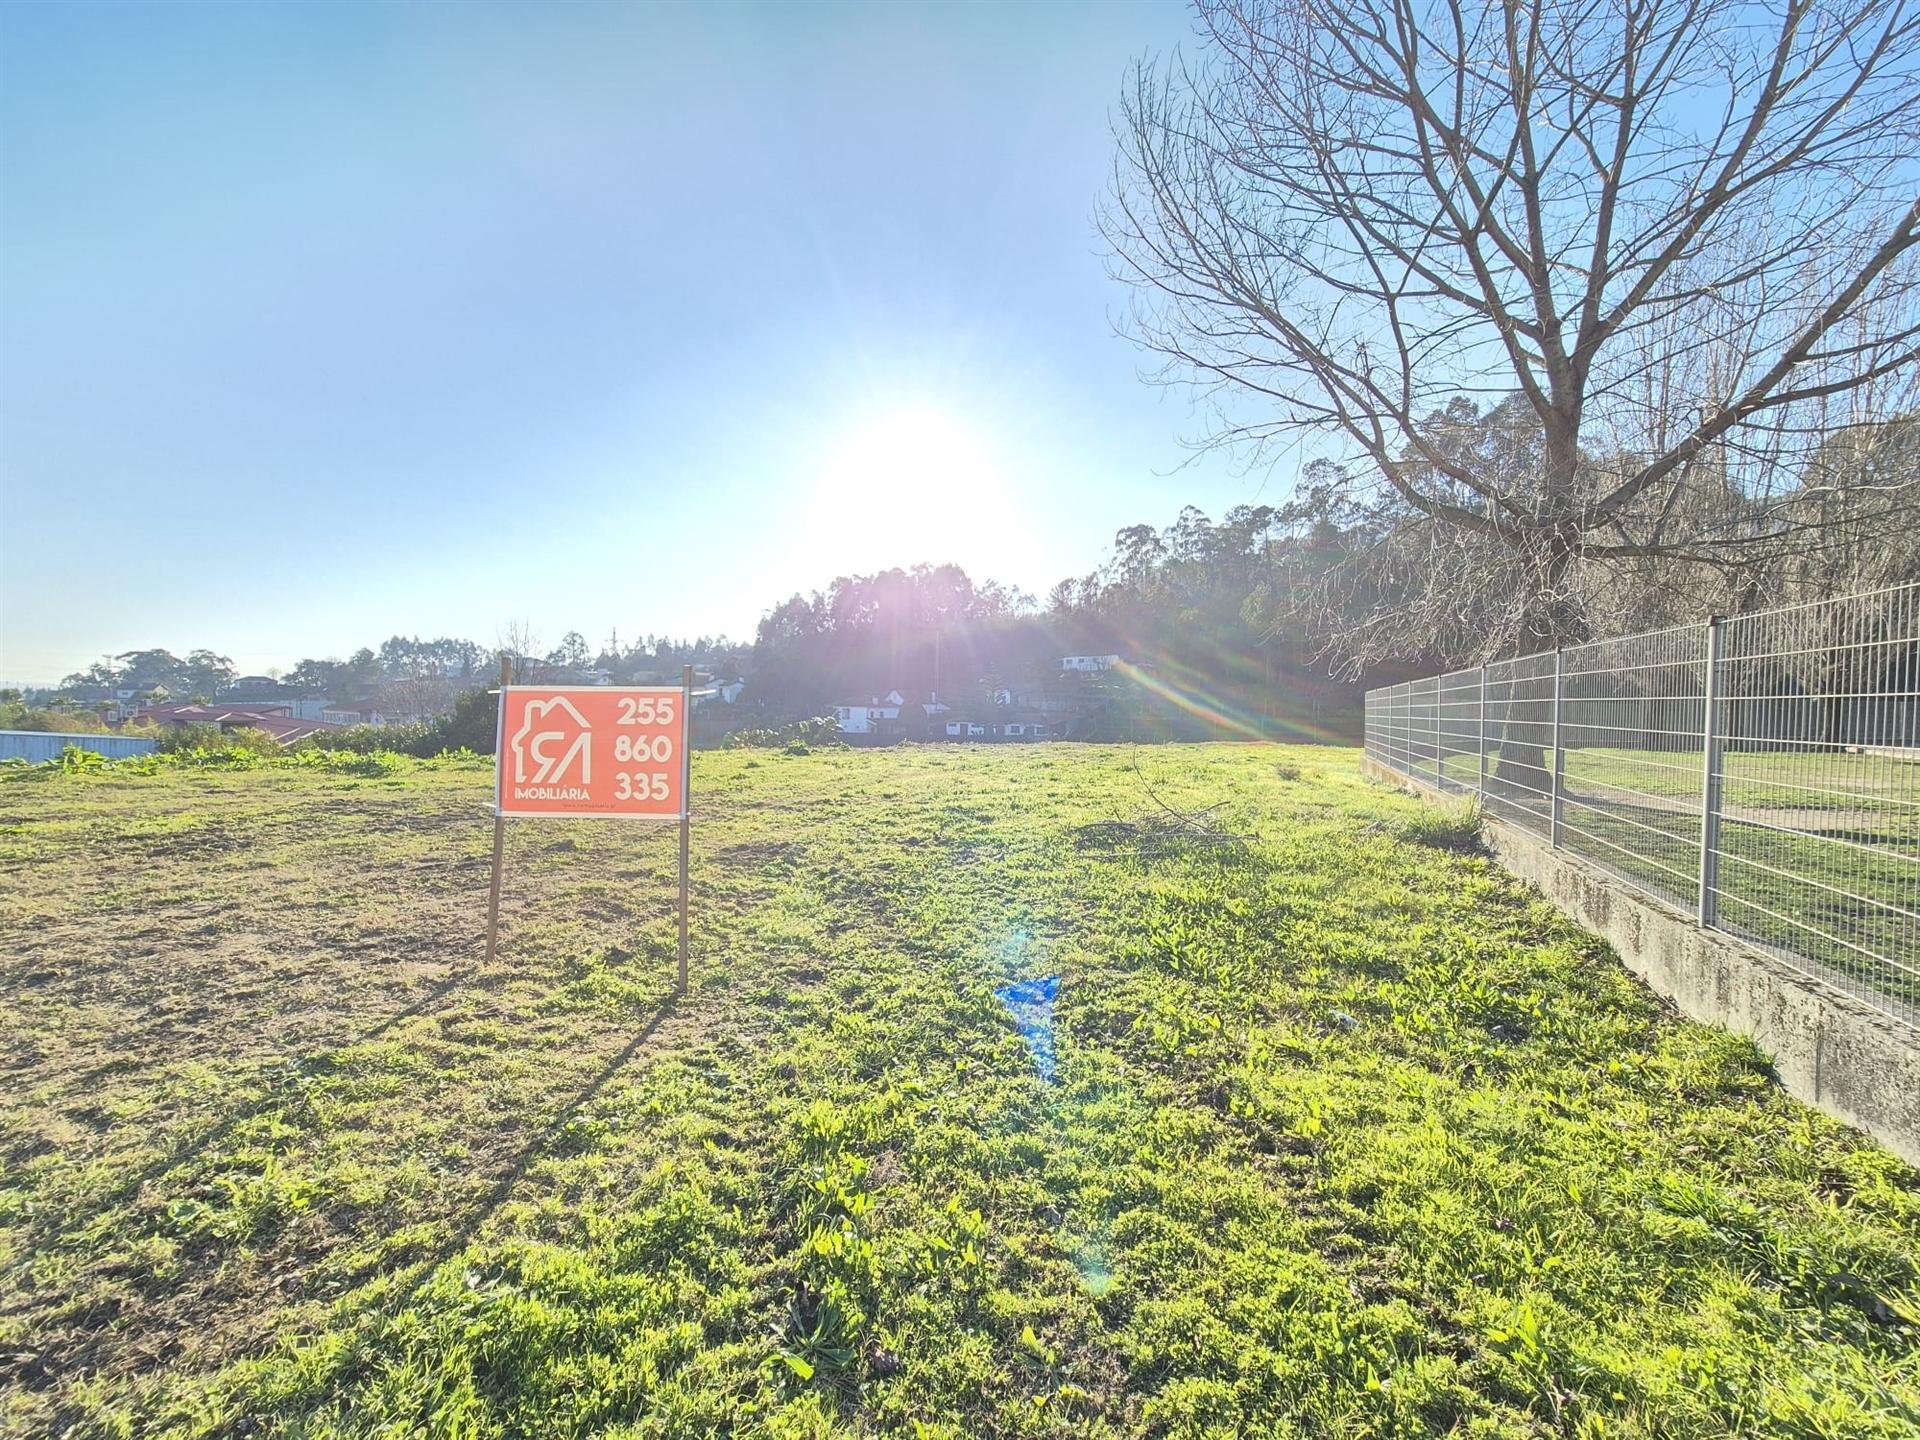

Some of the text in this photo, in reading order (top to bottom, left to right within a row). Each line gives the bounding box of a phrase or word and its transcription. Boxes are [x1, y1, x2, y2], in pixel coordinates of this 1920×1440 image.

[616, 697, 674, 725] 255
[614, 735, 672, 763] 860
[514, 785, 590, 801] IMOBILIÁRIA
[614, 772, 670, 801] 335
